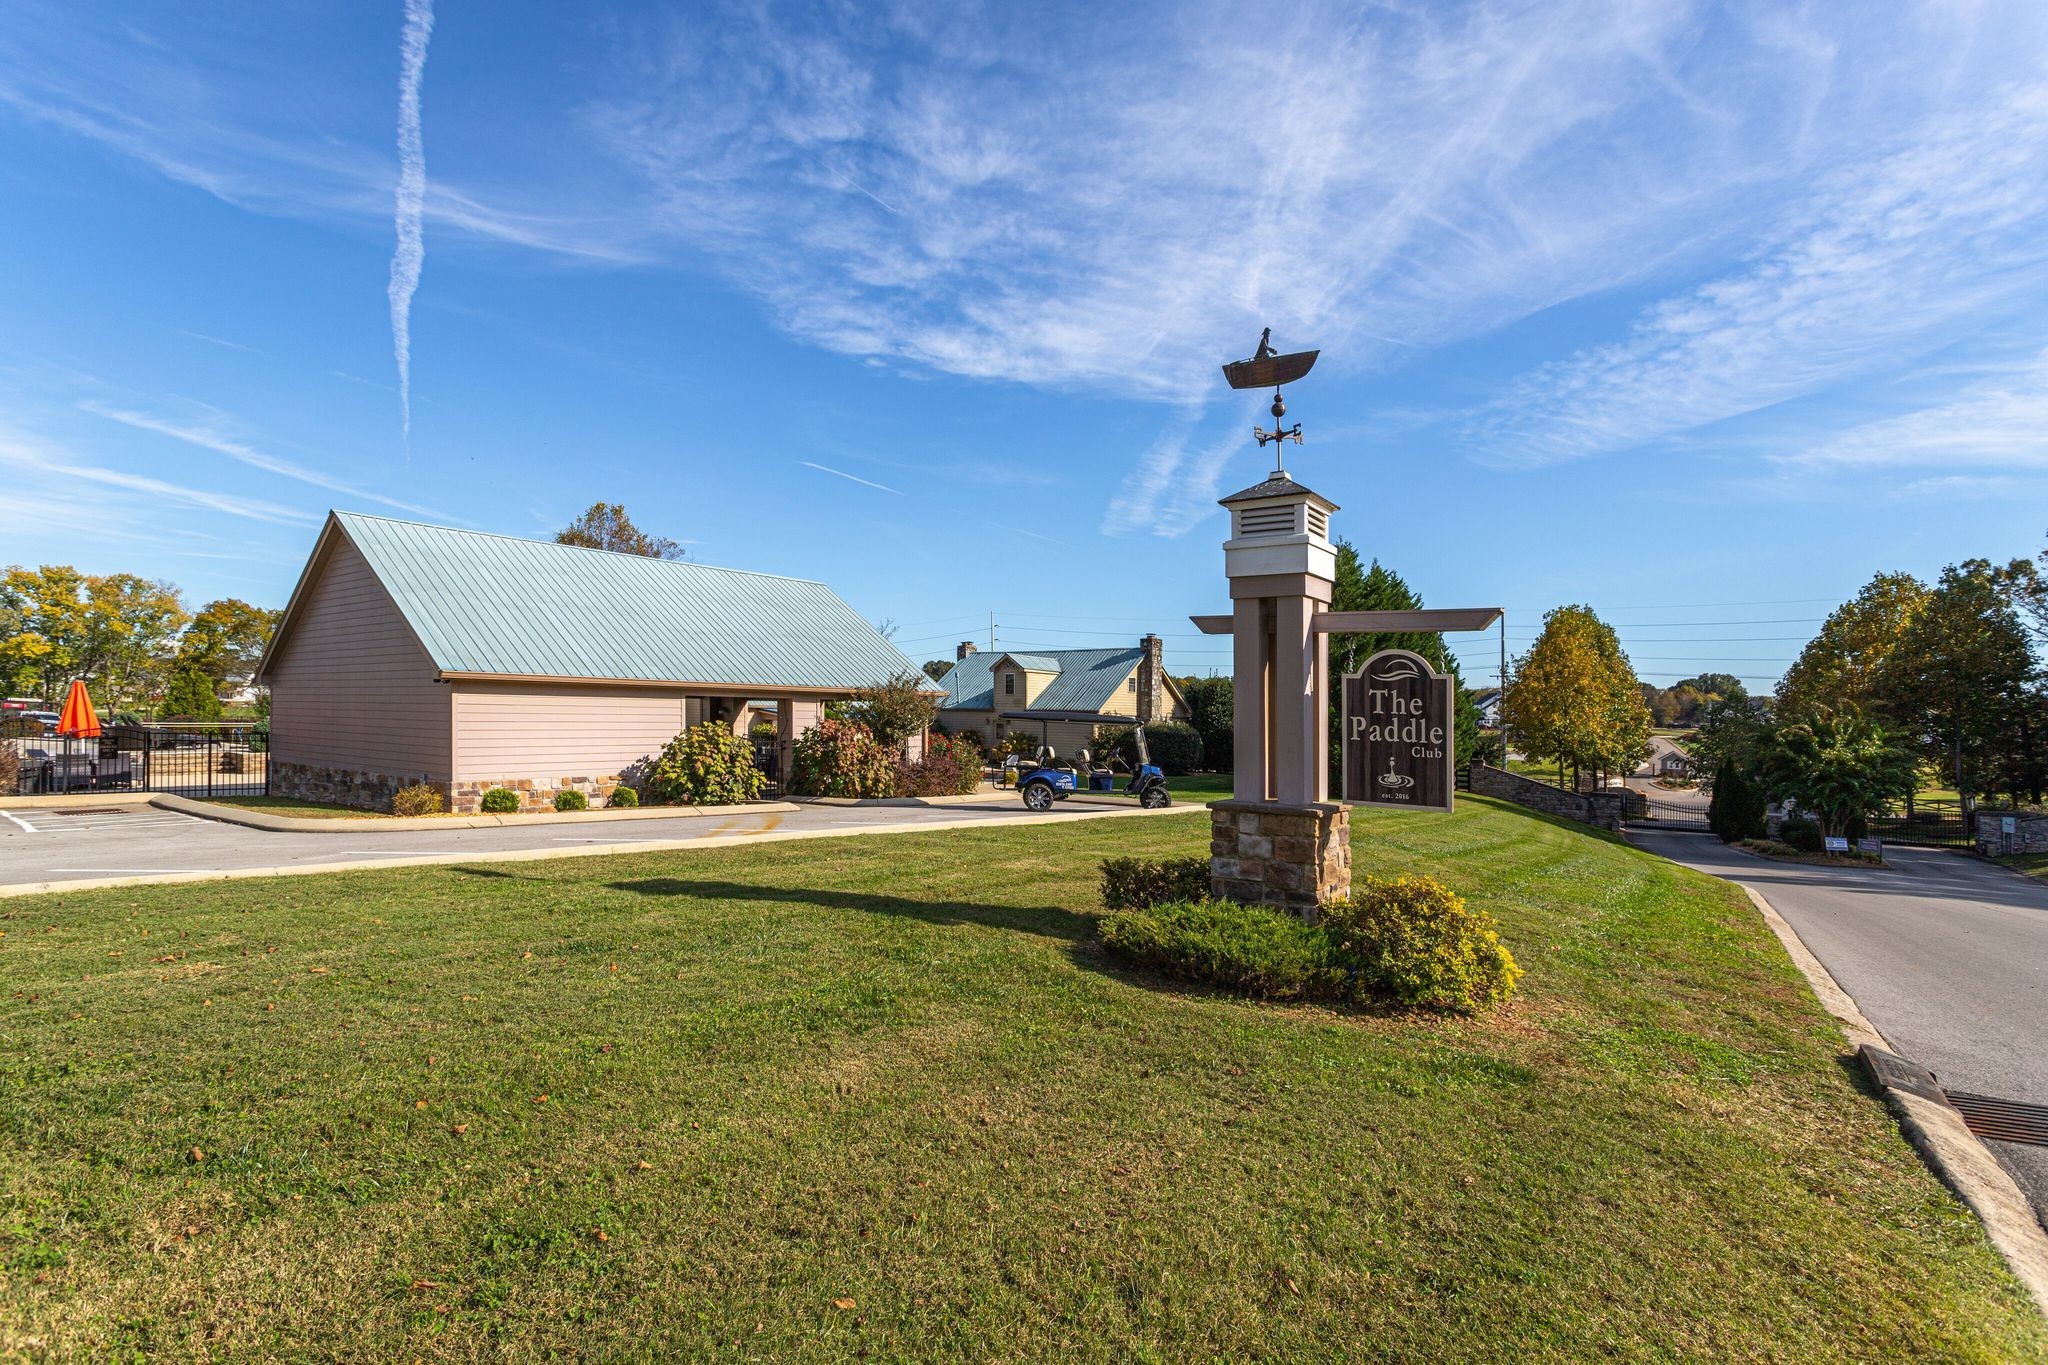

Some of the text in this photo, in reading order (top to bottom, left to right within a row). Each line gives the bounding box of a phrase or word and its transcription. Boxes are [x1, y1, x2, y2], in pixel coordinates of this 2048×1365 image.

[1368, 688, 1423, 715] The
[1350, 716, 1443, 744] Paddle
[1411, 746, 1442, 759] Club
[1395, 792, 1410, 800] 2016
